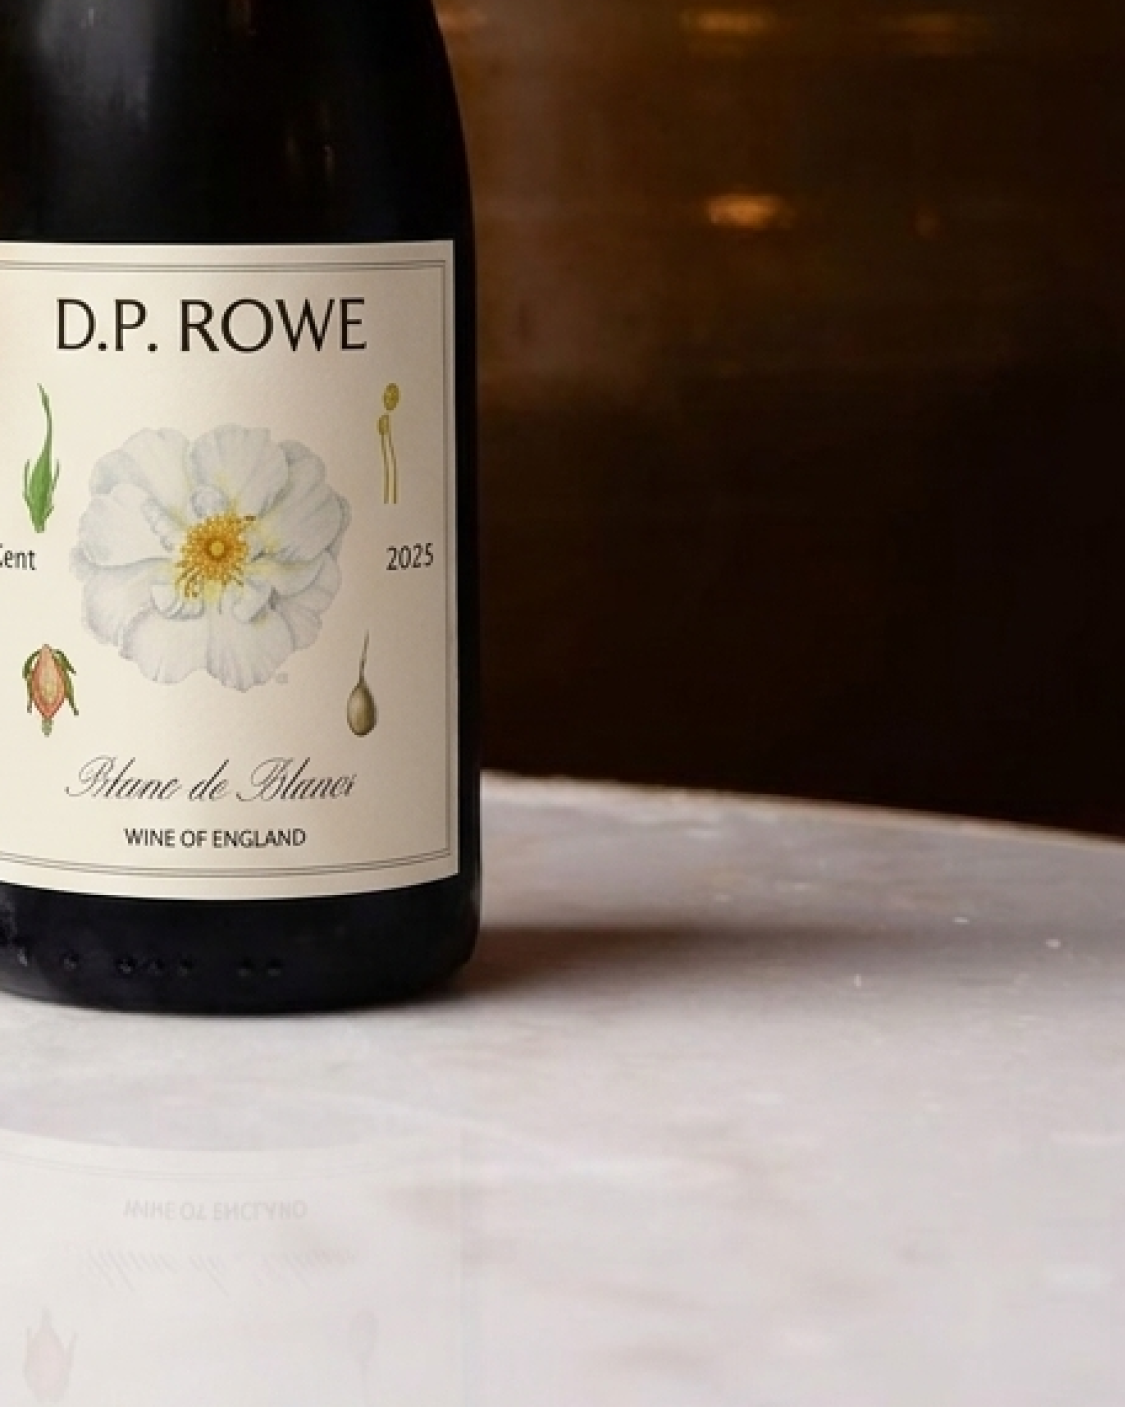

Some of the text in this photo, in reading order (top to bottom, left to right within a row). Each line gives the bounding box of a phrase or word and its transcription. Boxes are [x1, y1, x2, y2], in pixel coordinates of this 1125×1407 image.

[56, 297, 367, 354] D.P. ROWE
[385, 542, 435, 572] 2025
[63, 755, 183, 801] Blanc
[186, 758, 230, 802] de
[123, 827, 307, 849] WINE OF ENGLAND
